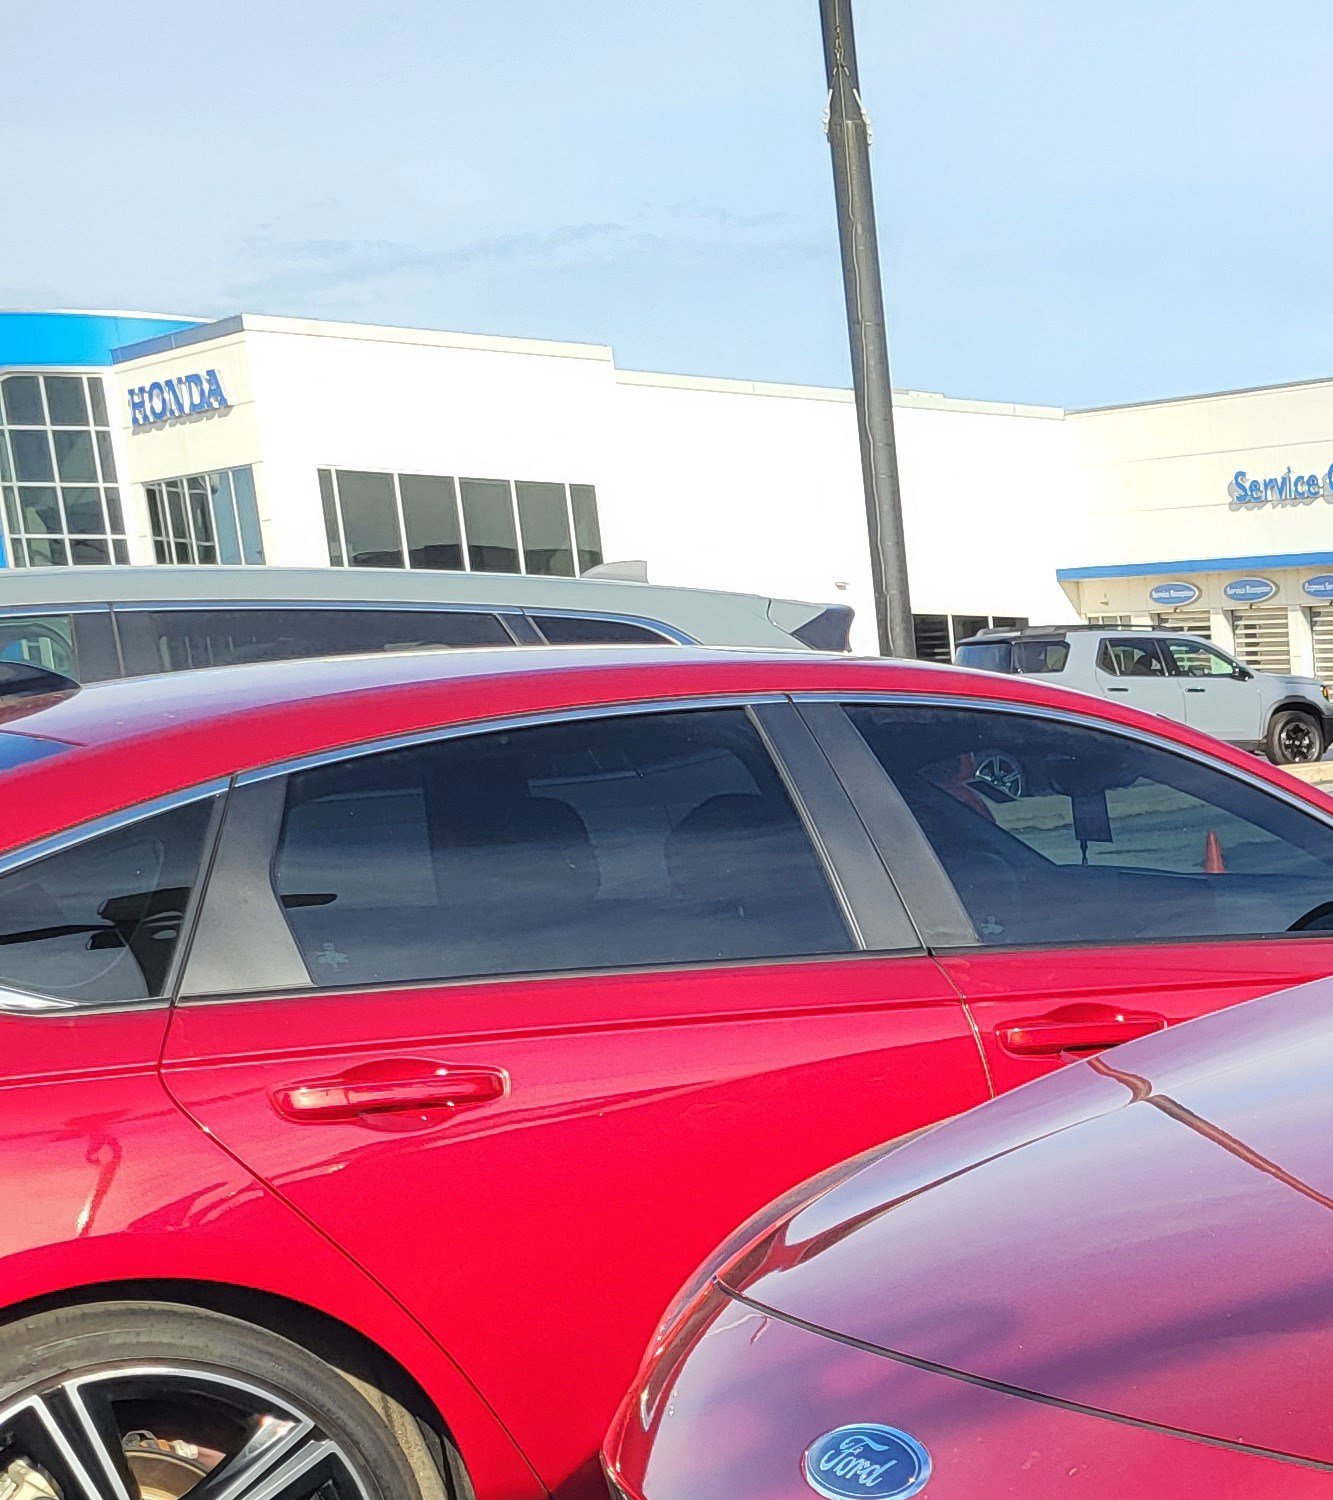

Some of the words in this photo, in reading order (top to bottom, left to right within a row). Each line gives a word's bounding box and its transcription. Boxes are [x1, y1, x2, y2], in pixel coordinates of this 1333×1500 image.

[127, 369, 229, 426] HONDA
[1234, 466, 1320, 502] Service
[819, 1435, 898, 1487] Ford
